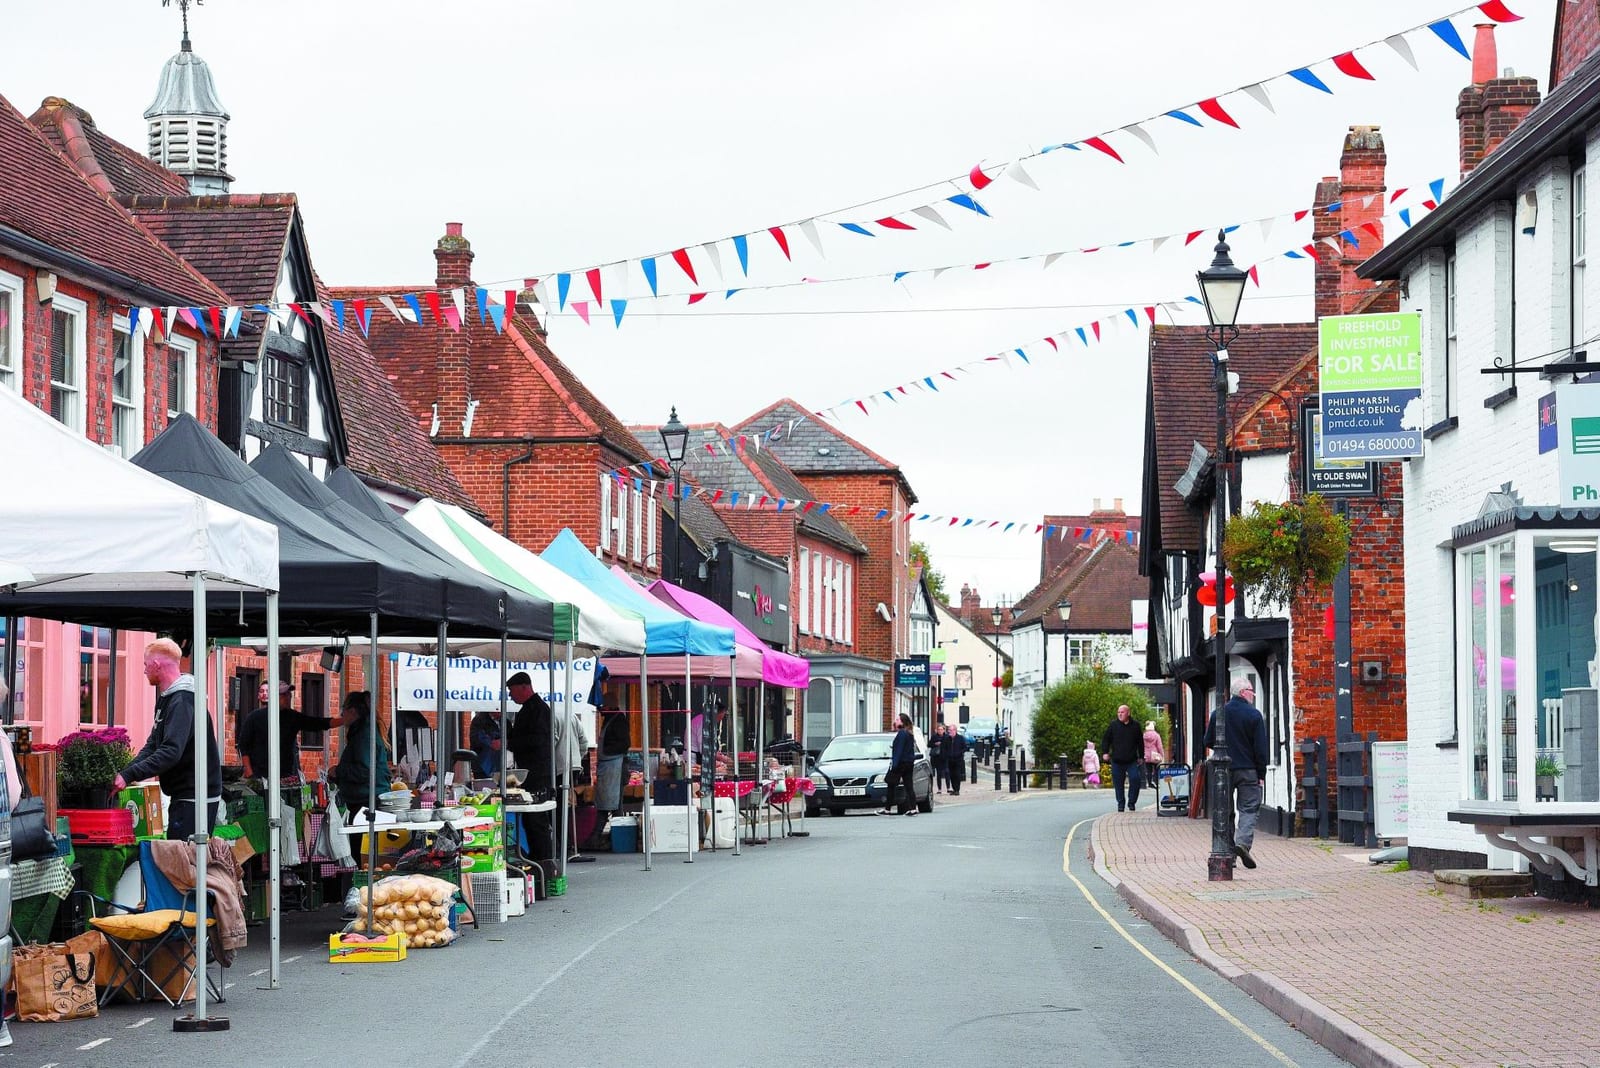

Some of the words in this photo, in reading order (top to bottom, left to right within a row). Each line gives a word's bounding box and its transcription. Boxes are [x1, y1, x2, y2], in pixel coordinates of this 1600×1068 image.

[1338, 319, 1401, 333] FREEHOLD
[1330, 335, 1410, 351] INVESTMENT
[1325, 354, 1364, 374] FOR
[1371, 352, 1417, 372] SALE
[1328, 398, 1355, 406] PHILIP
[1357, 396, 1390, 405] MARSH
[1328, 407, 1365, 416] COLLINS
[1367, 405, 1401, 414] DEUNG
[1328, 416, 1385, 431] pmcd.co.uk
[1328, 439, 1366, 453] 01494
[1368, 437, 1415, 451] 680000
[1312, 472, 1322, 481] YE
[1323, 472, 1344, 480] OLDE
[1345, 471, 1368, 480] SWAN
[1572, 484, 1600, 501] Ph
[900, 663, 926, 672] Frost
[413, 688, 435, 700] on
